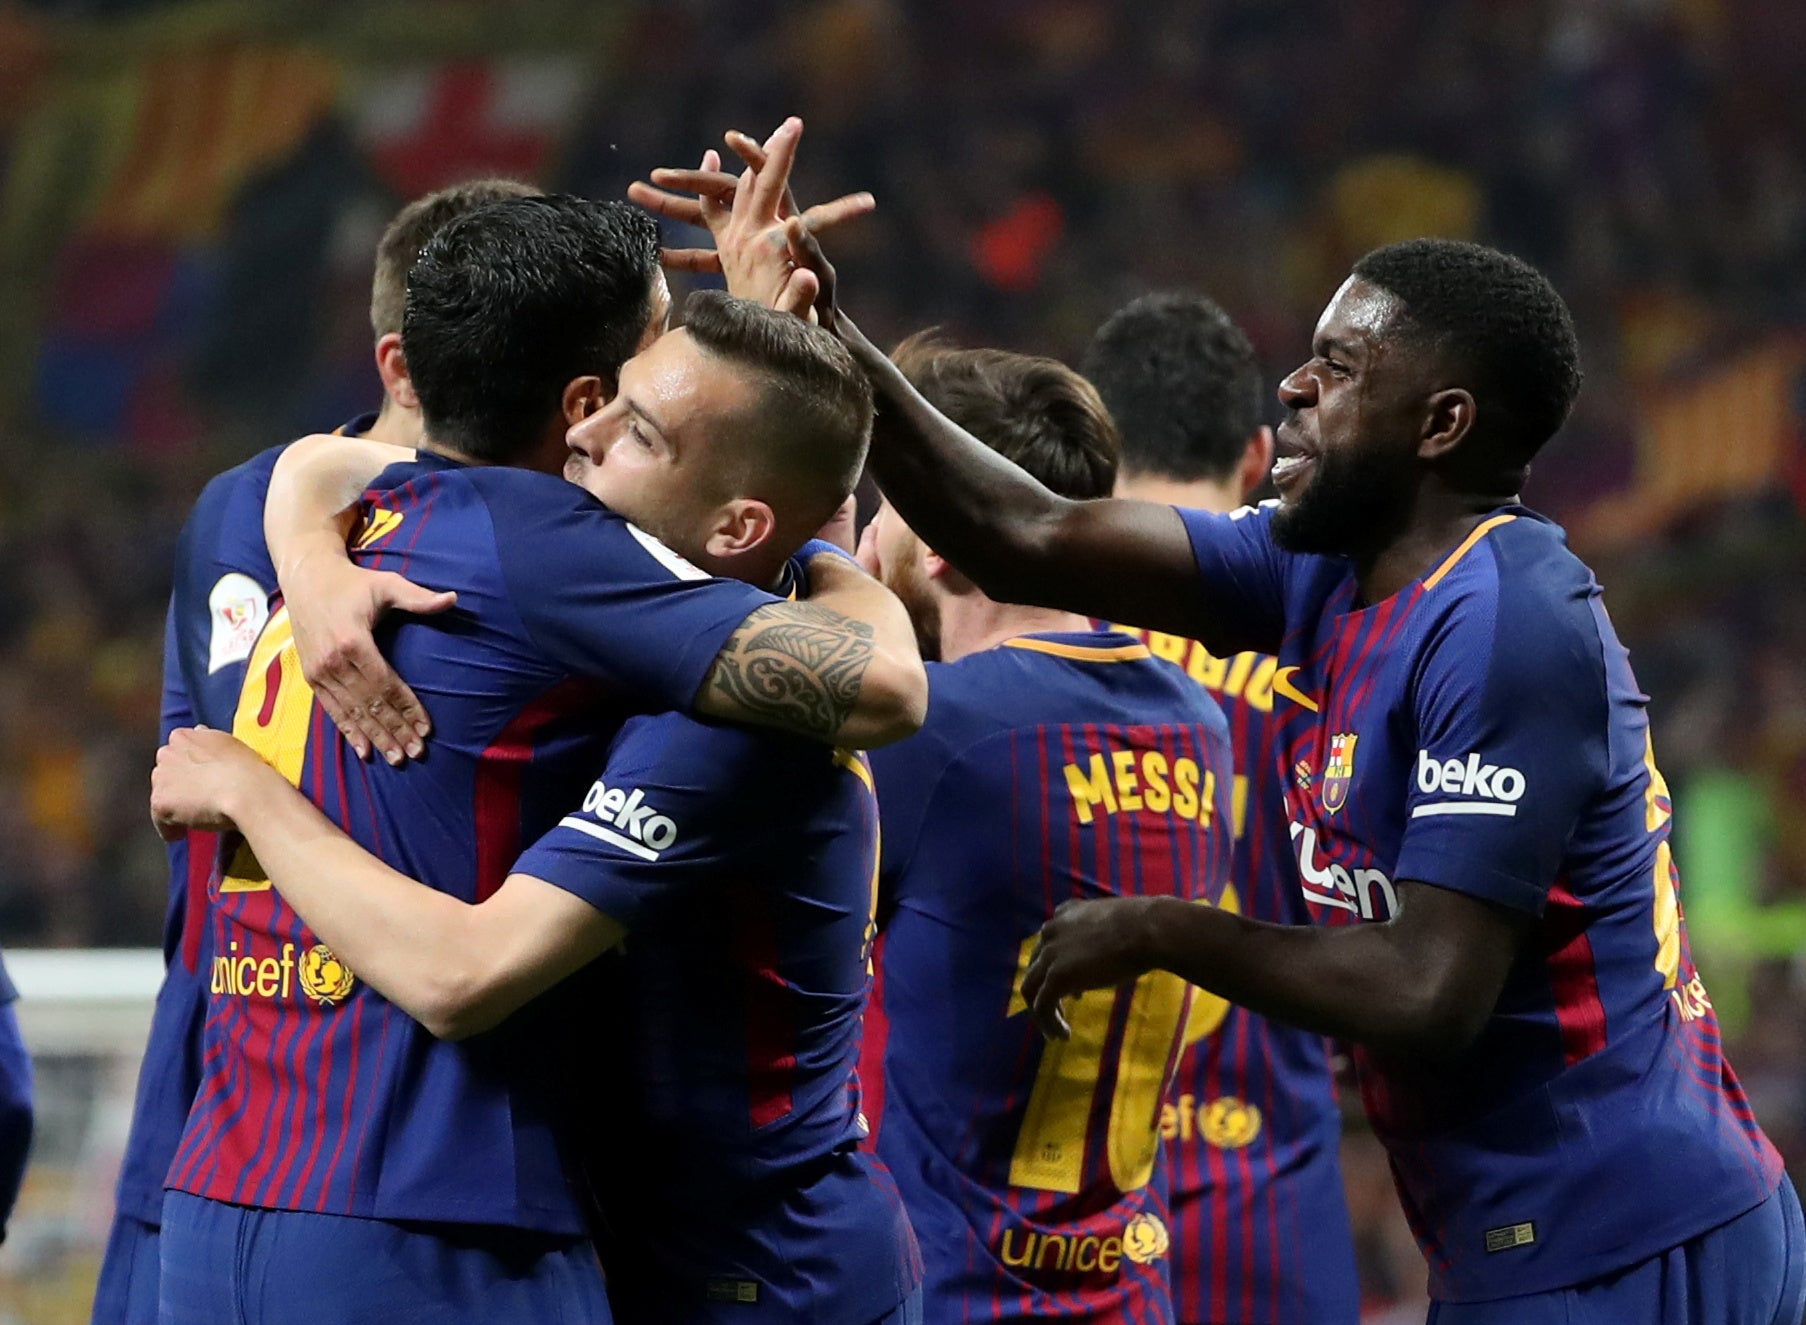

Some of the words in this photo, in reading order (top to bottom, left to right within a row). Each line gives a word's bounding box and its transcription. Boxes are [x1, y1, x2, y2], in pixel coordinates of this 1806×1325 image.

[1063, 751, 1215, 828] MESSI
[1416, 749, 1526, 801] beko
[211, 941, 294, 998] unicef
[1001, 1228, 1123, 1273] unice
